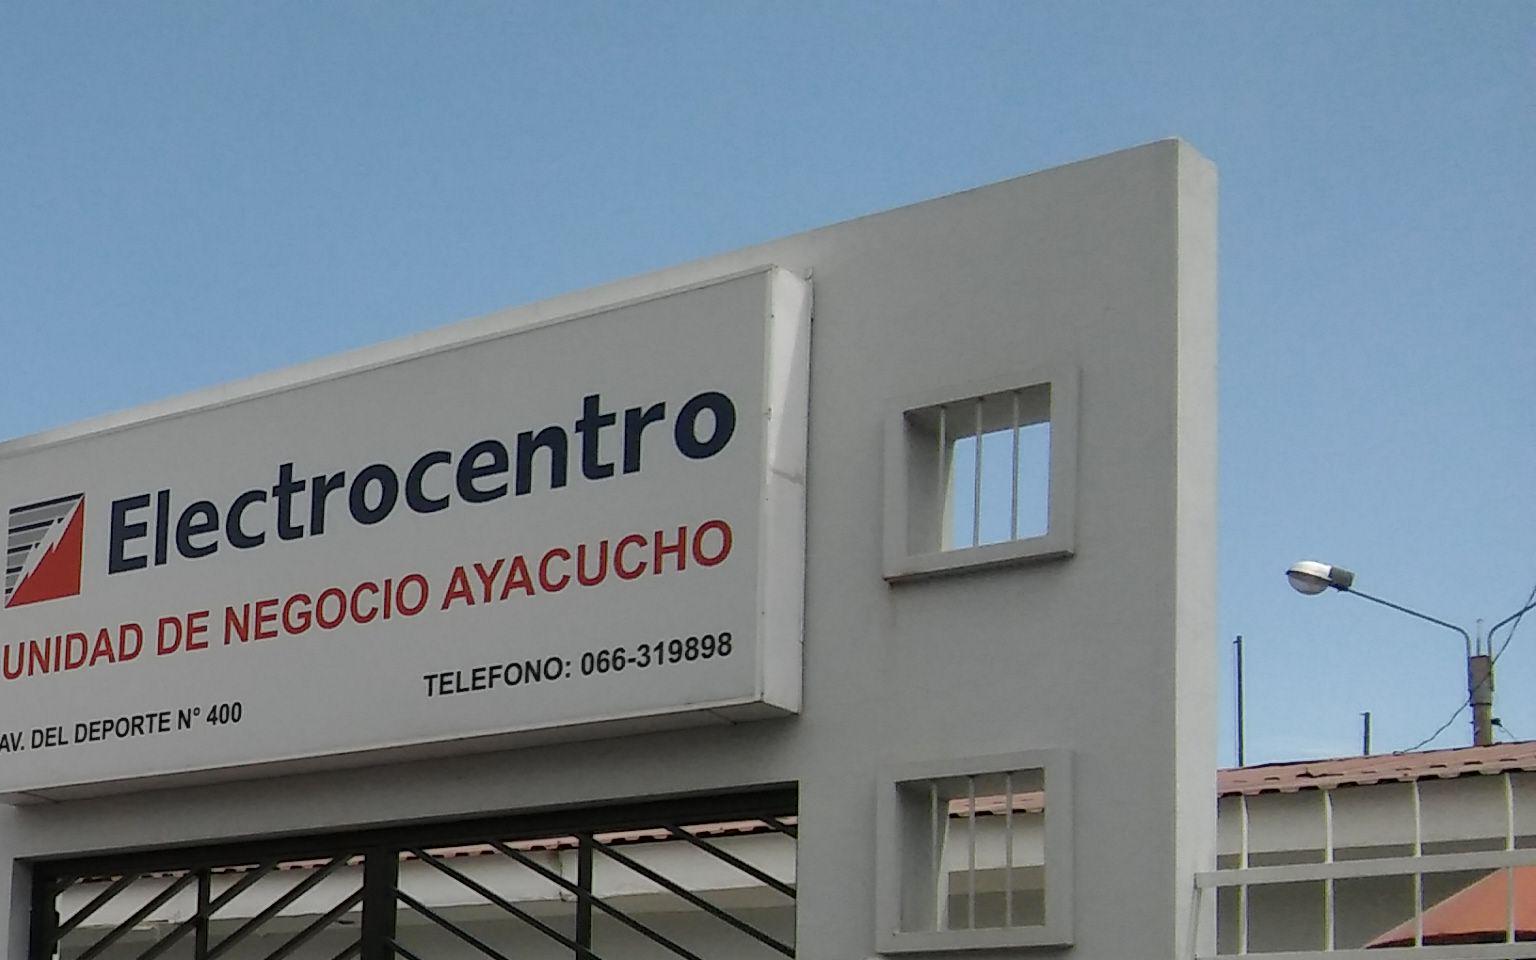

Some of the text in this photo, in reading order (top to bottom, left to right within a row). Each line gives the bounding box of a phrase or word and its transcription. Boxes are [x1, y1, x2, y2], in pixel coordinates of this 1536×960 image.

[108, 390, 737, 575] Electrocentro
[2, 519, 733, 681] UNIDAD DE NEGOCIO AYACUCHO
[423, 631, 734, 698] TELEFONO: 066-319898
[31, 726, 69, 750] DEL
[74, 711, 172, 744] DEPORTE
[206, 701, 243, 726] 400
